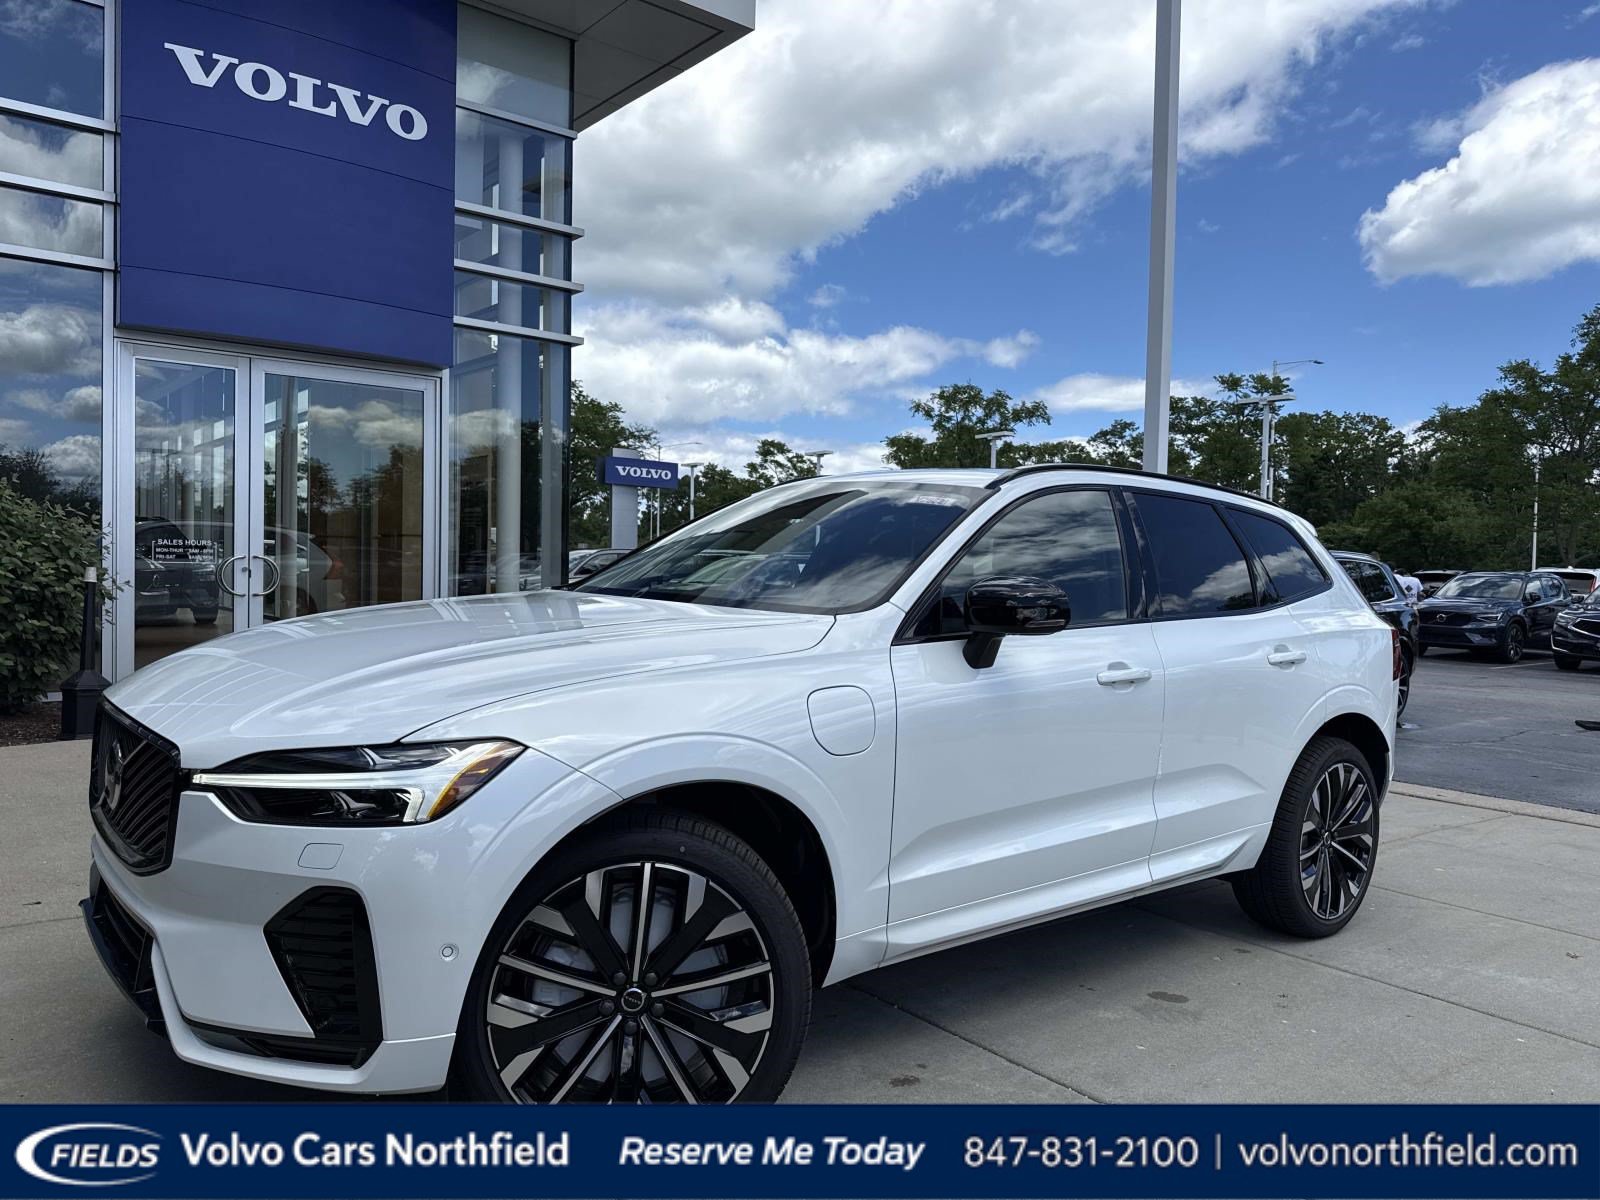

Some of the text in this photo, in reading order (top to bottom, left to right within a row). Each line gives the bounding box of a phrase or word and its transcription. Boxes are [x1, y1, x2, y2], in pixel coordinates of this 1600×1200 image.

[164, 42, 428, 141] VOLVO
[616, 465, 672, 480] VOLVO
[157, 538, 212, 547] SALES HOURS
